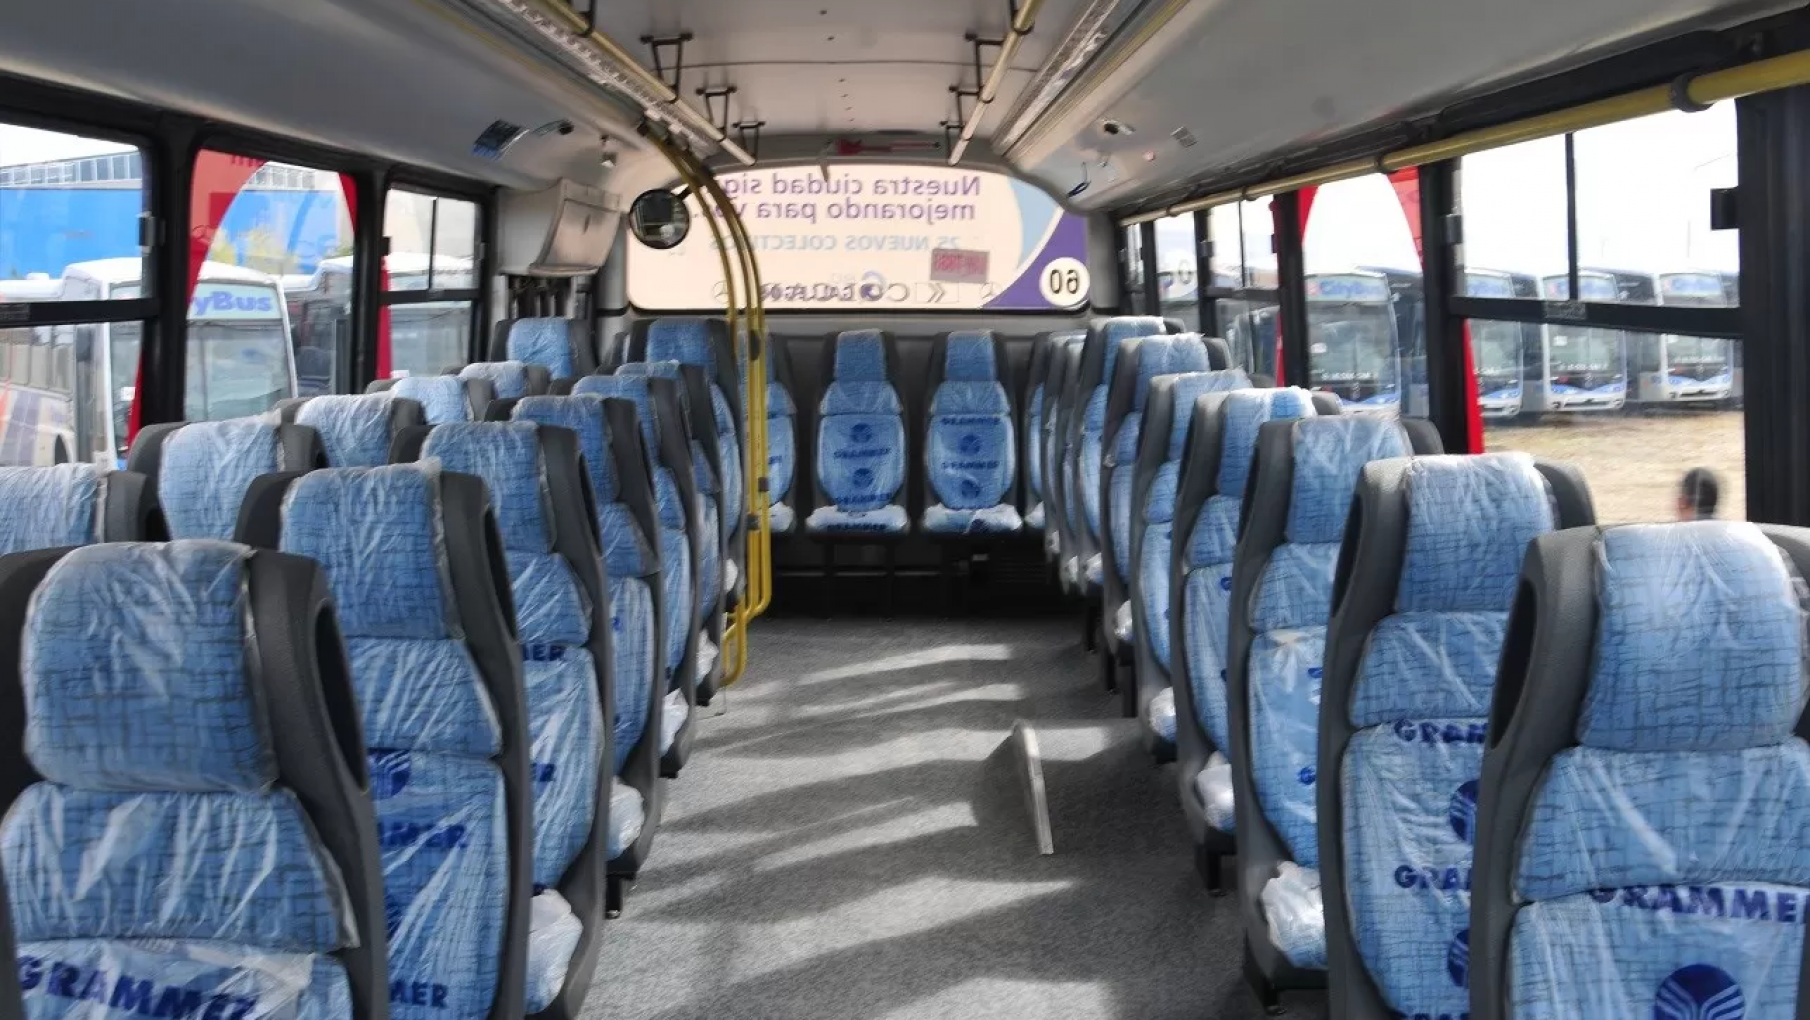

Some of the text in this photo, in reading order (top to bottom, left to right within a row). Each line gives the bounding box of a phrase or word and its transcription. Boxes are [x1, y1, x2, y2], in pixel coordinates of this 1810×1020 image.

[193, 291, 271, 316] yBus
[1394, 718, 1489, 744] GRAM
[1588, 883, 1810, 923] GRAMME
